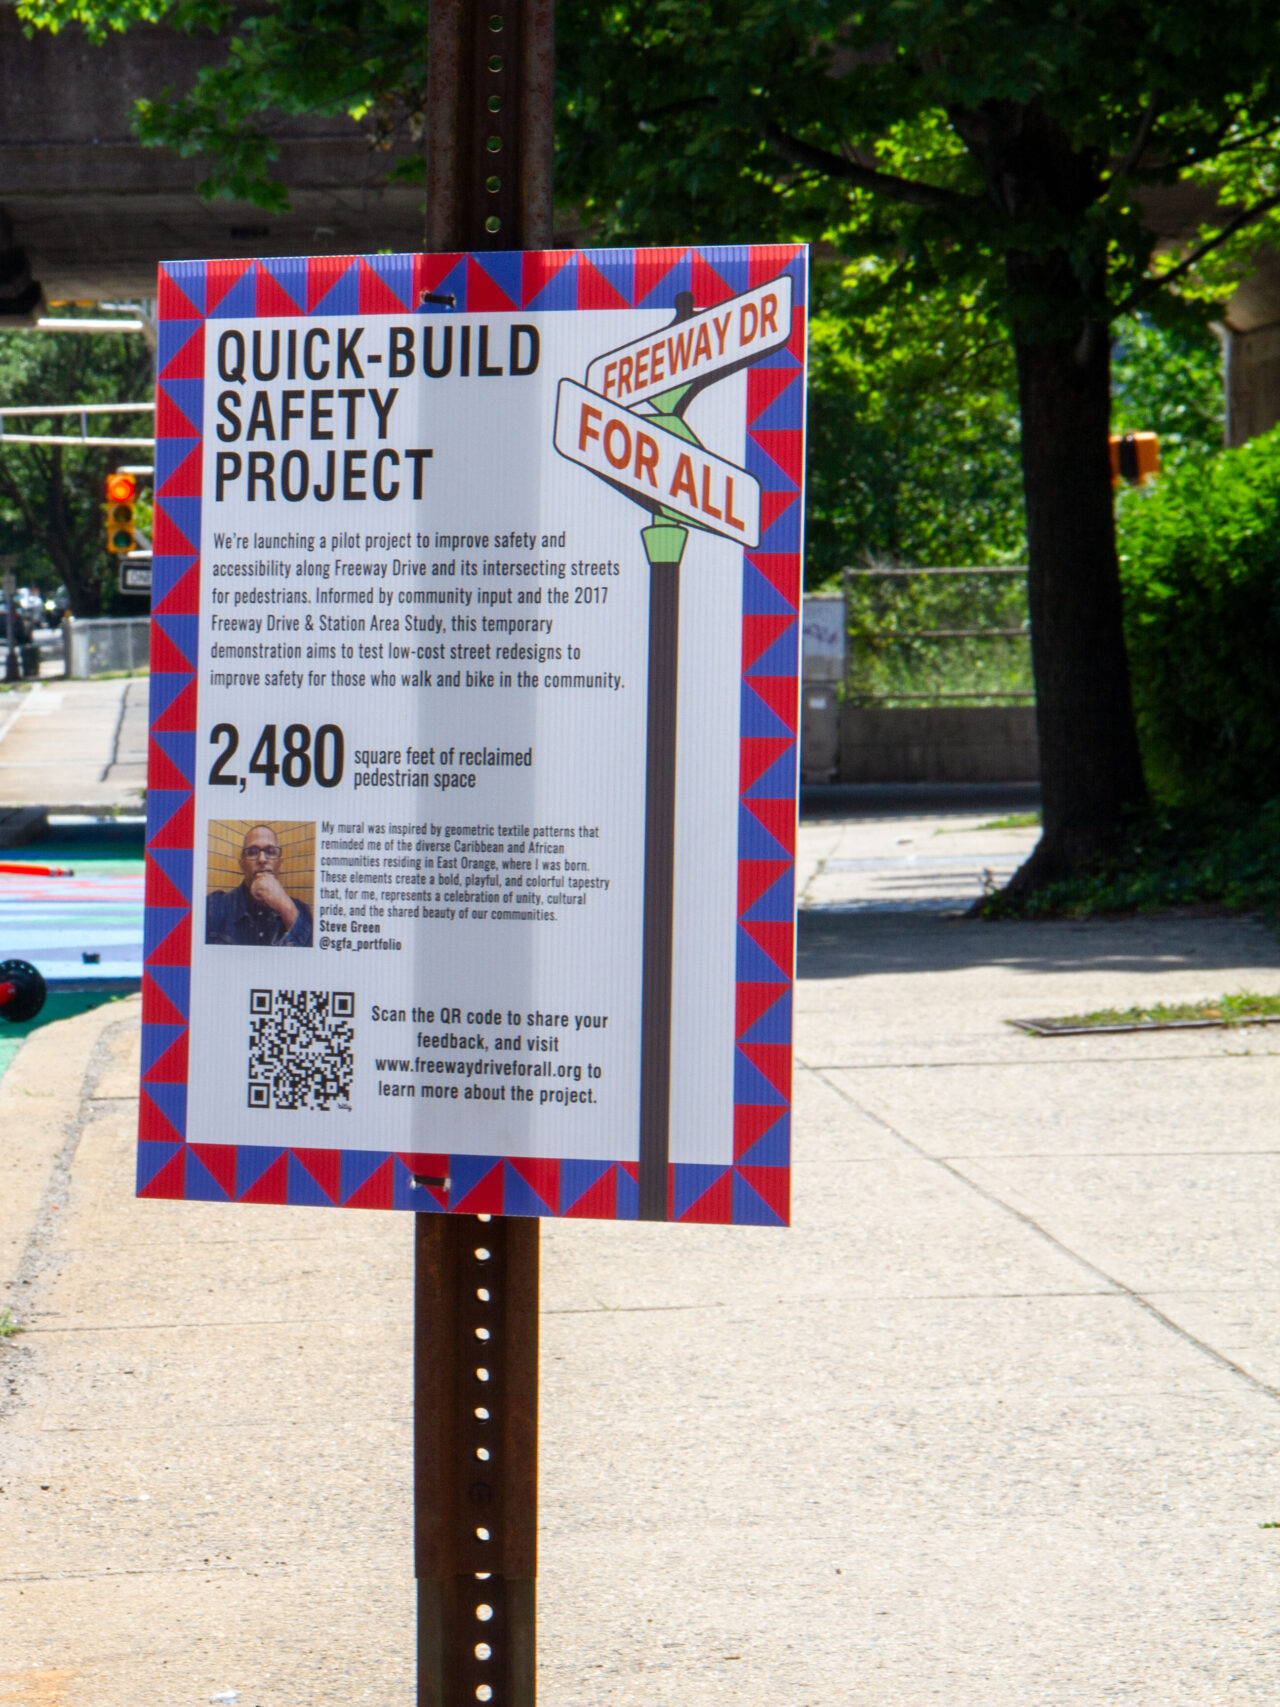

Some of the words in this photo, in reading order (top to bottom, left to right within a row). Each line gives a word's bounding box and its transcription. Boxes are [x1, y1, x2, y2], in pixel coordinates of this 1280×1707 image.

[217, 324, 541, 385] QUICK-BUILD
[603, 311, 733, 398] FREEWAY
[739, 292, 779, 348] DR
[216, 387, 400, 442] SAFETY
[215, 448, 434, 502] PROJECT
[578, 402, 660, 489] FOR
[669, 452, 746, 532] ALL
[214, 533, 248, 549] We're
[255, 532, 314, 552] launching
[320, 536, 326, 548] a
[332, 532, 360, 552] pilot
[366, 533, 411, 551] project
[417, 533, 429, 548] to
[436, 532, 488, 551] improve
[495, 532, 536, 550] safety
[542, 531, 565, 547] and
[213, 560, 291, 579] accessibility
[296, 559, 330, 579] along
[335, 559, 387, 579] Freeway
[393, 559, 426, 576] Drive
[432, 559, 455, 576] and
[461, 560, 477, 576] its
[483, 560, 566, 579] intersecting
[571, 560, 620, 576] streets
[212, 588, 229, 604] for
[235, 587, 311, 607] pedestrians.
[317, 587, 373, 603] Informed
[379, 587, 393, 606] by
[399, 588, 472, 606] community
[478, 588, 512, 607] input
[518, 587, 541, 604] and
[548, 587, 569, 604] the
[575, 587, 608, 604] 2017
[212, 615, 261, 633] Freeway
[268, 615, 298, 631] Drive
[306, 615, 313, 631] &
[320, 615, 364, 631] Station
[371, 615, 399, 631] Area
[406, 615, 445, 633] Study,
[452, 615, 476, 631] this
[483, 616, 552, 634] temporary
[211, 642, 301, 659] demonstration
[306, 642, 336, 659] aims
[341, 643, 353, 659] to
[358, 643, 384, 659] test
[389, 642, 445, 659] low-cost
[450, 643, 491, 660] street
[496, 642, 562, 663] redesigns
[567, 644, 581, 660] to
[211, 670, 260, 689] improve
[265, 670, 303, 688] safety
[308, 670, 326, 686] for
[331, 670, 365, 686] those
[371, 670, 396, 686] who
[401, 670, 431, 687] walk
[437, 671, 460, 687] and
[466, 670, 494, 687] bike
[500, 671, 511, 687] in
[517, 671, 538, 687] the
[544, 672, 624, 691] community.
[208, 722, 345, 793] 2,480
[354, 750, 401, 768] square
[406, 747, 435, 765] feet
[440, 747, 455, 765] of
[459, 747, 532, 766] reclaimed
[354, 769, 429, 790] pedestrian
[434, 773, 476, 791] space
[321, 821, 336, 835] My
[337, 822, 365, 834] mural
[367, 825, 387, 834] was
[388, 822, 428, 837] inspired
[429, 823, 443, 837] by
[444, 824, 495, 838] geometric
[497, 824, 530, 837] textile
[532, 825, 576, 839] patterns
[577, 825, 600, 838] that
[320, 839, 365, 850] reminded
[366, 841, 382, 851] me
[383, 839, 395, 851] of
[396, 840, 413, 851] the
[415, 840, 452, 852] diverse
[453, 840, 505, 853] Caribbean
[506, 841, 526, 854] and
[527, 841, 565, 854] African
[320, 856, 380, 867] communities
[383, 856, 422, 870] residing
[424, 857, 434, 868] in
[437, 857, 458, 868] East
[461, 857, 498, 871] Orange,
[502, 858, 532, 870] where
[535, 858, 540, 870] I
[542, 862, 561, 870] was
[564, 859, 590, 871] born.
[320, 871, 347, 883] These
[350, 872, 393, 884] elements
[395, 874, 426, 884] create
[429, 876, 435, 885] a
[438, 873, 462, 886] bold,
[465, 874, 502, 888] playful,
[504, 875, 523, 887] and
[526, 876, 565, 887] colorful
[568, 877, 610, 890] tapestry
[319, 888, 342, 900] that,
[344, 888, 358, 899] for
[361, 891, 378, 901] me,
[381, 891, 432, 903] represents
[434, 893, 441, 901] a
[444, 890, 500, 903] celebration
[502, 892, 514, 903] of
[516, 892, 545, 905] unity,
[547, 893, 586, 905] cultural
[319, 904, 347, 918] pride,
[348, 905, 367, 916] and
[368, 905, 385, 917] the
[387, 906, 420, 918] shared
[422, 906, 457, 920] beauty
[458, 907, 470, 919] of
[471, 910, 489, 919] our
[490, 909, 558, 921] communities.
[319, 921, 347, 932] Steve
[350, 921, 381, 933] Green
[318, 936, 402, 952] @sgfa_portfolio
[371, 1005, 407, 1022] Scan
[411, 1007, 435, 1023] the
[440, 1008, 462, 1024] QR
[466, 1009, 502, 1025] code
[506, 1010, 522, 1026] to
[526, 1010, 570, 1027] share
[574, 1015, 609, 1031] your
[416, 1032, 490, 1052] feedback,
[494, 1035, 522, 1051] and
[526, 1036, 560, 1052] visit
[375, 1057, 582, 1081] www.freewaydriveforall.org
[587, 1063, 602, 1078] to
[378, 1080, 416, 1097] learn
[420, 1085, 459, 1099] more
[463, 1084, 506, 1100] about
[509, 1085, 535, 1102] the
[539, 1087, 598, 1106] project.
